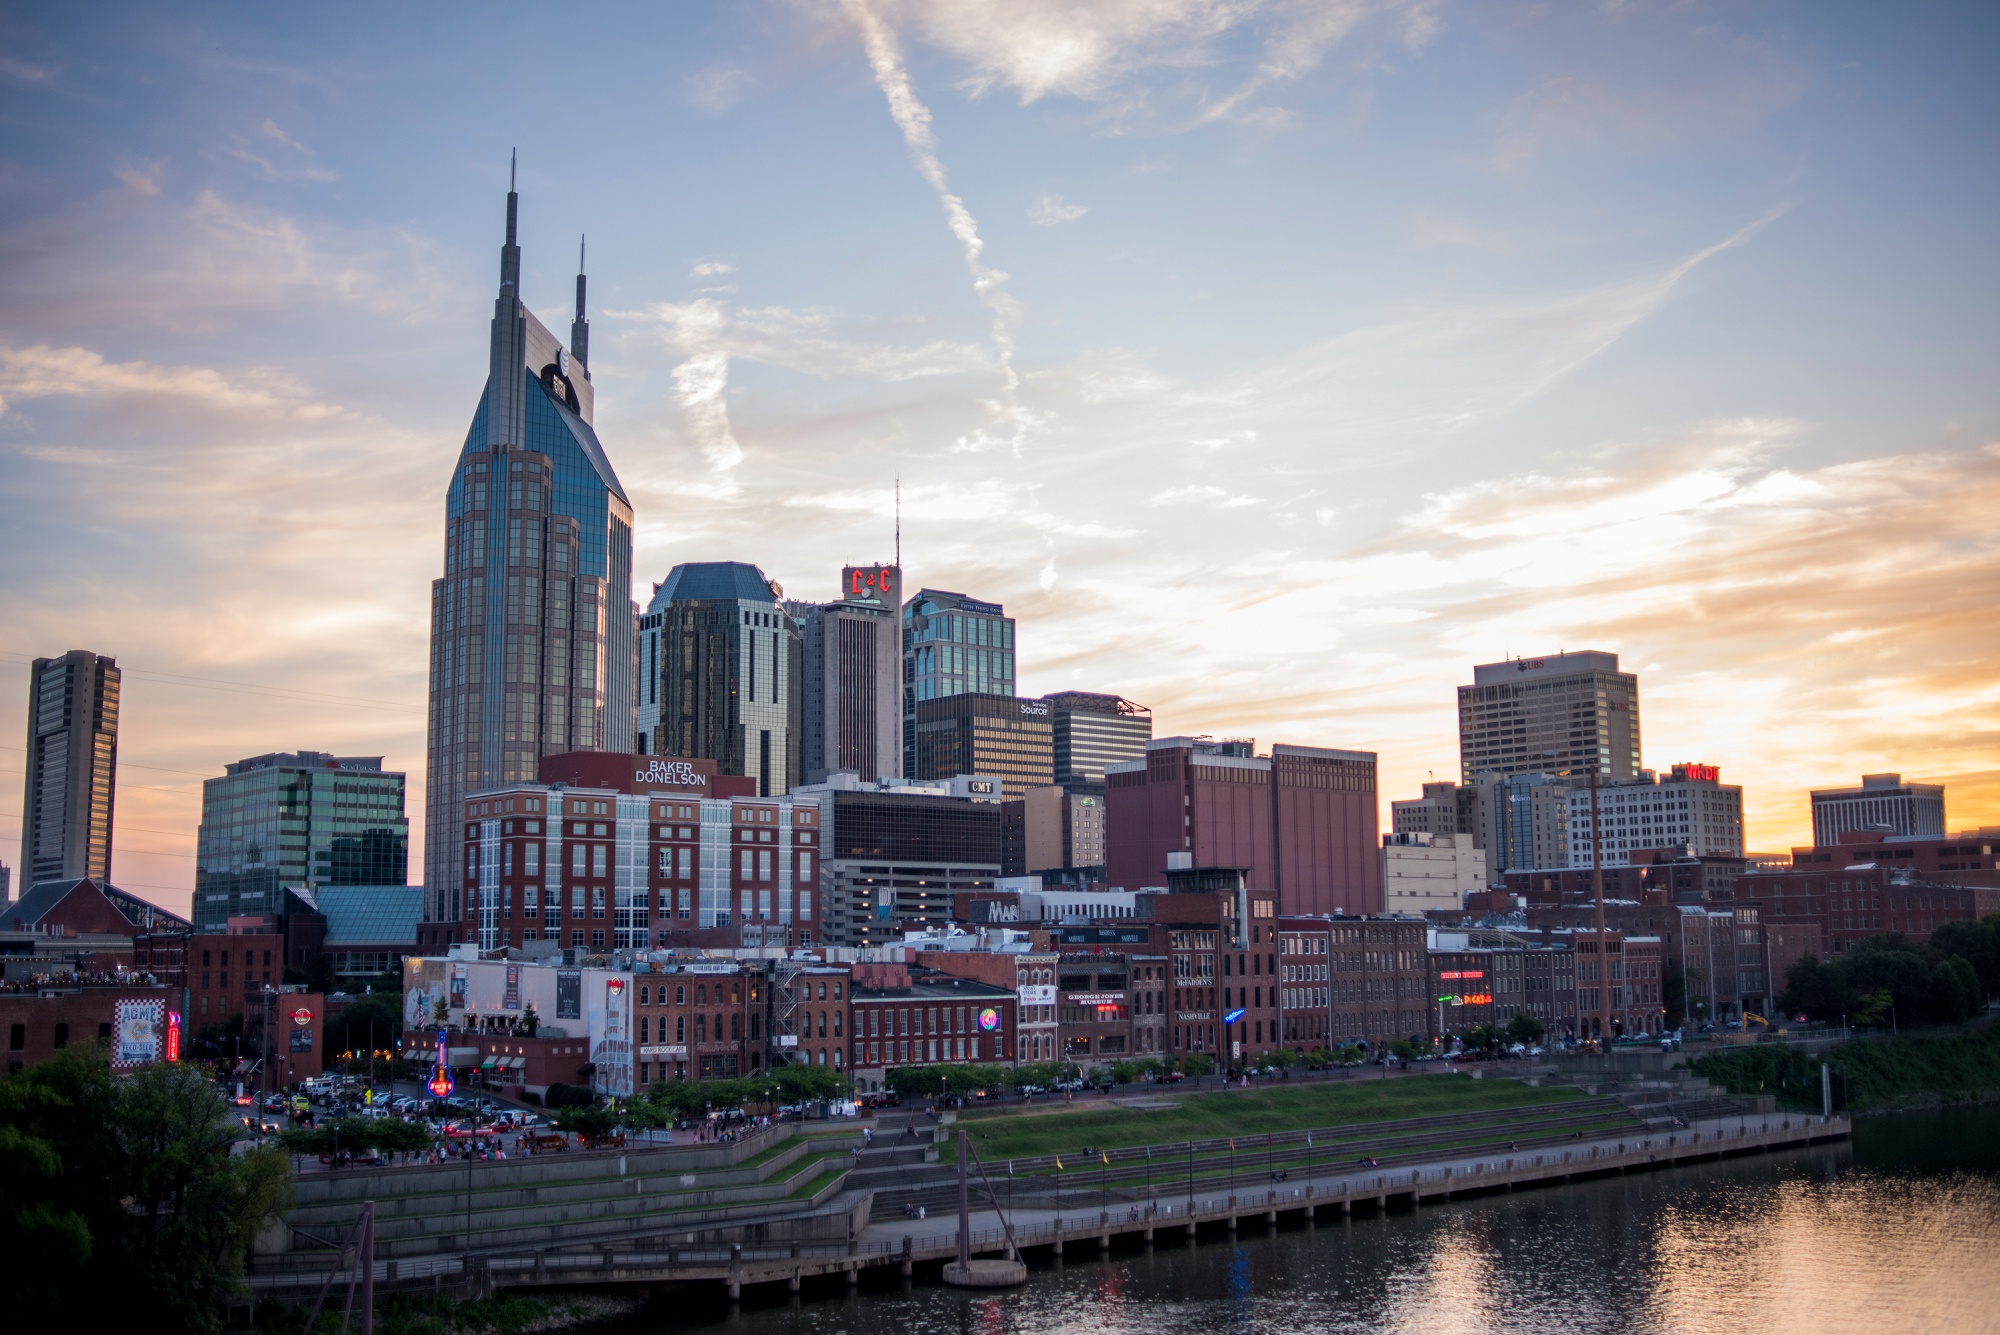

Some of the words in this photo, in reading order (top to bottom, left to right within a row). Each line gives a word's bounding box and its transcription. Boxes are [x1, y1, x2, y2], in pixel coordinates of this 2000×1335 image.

[1527, 660, 1544, 670] UBS
[1020, 704, 1047, 716] Source
[1616, 703, 1628, 712] UBS
[649, 760, 692, 774] BAKER
[635, 770, 706, 786] DONELSON
[972, 782, 991, 793] CMT
[122, 1007, 157, 1024] ACME
[1178, 1012, 1211, 1020] NASHVILLE
[138, 1043, 153, 1051] SEED
